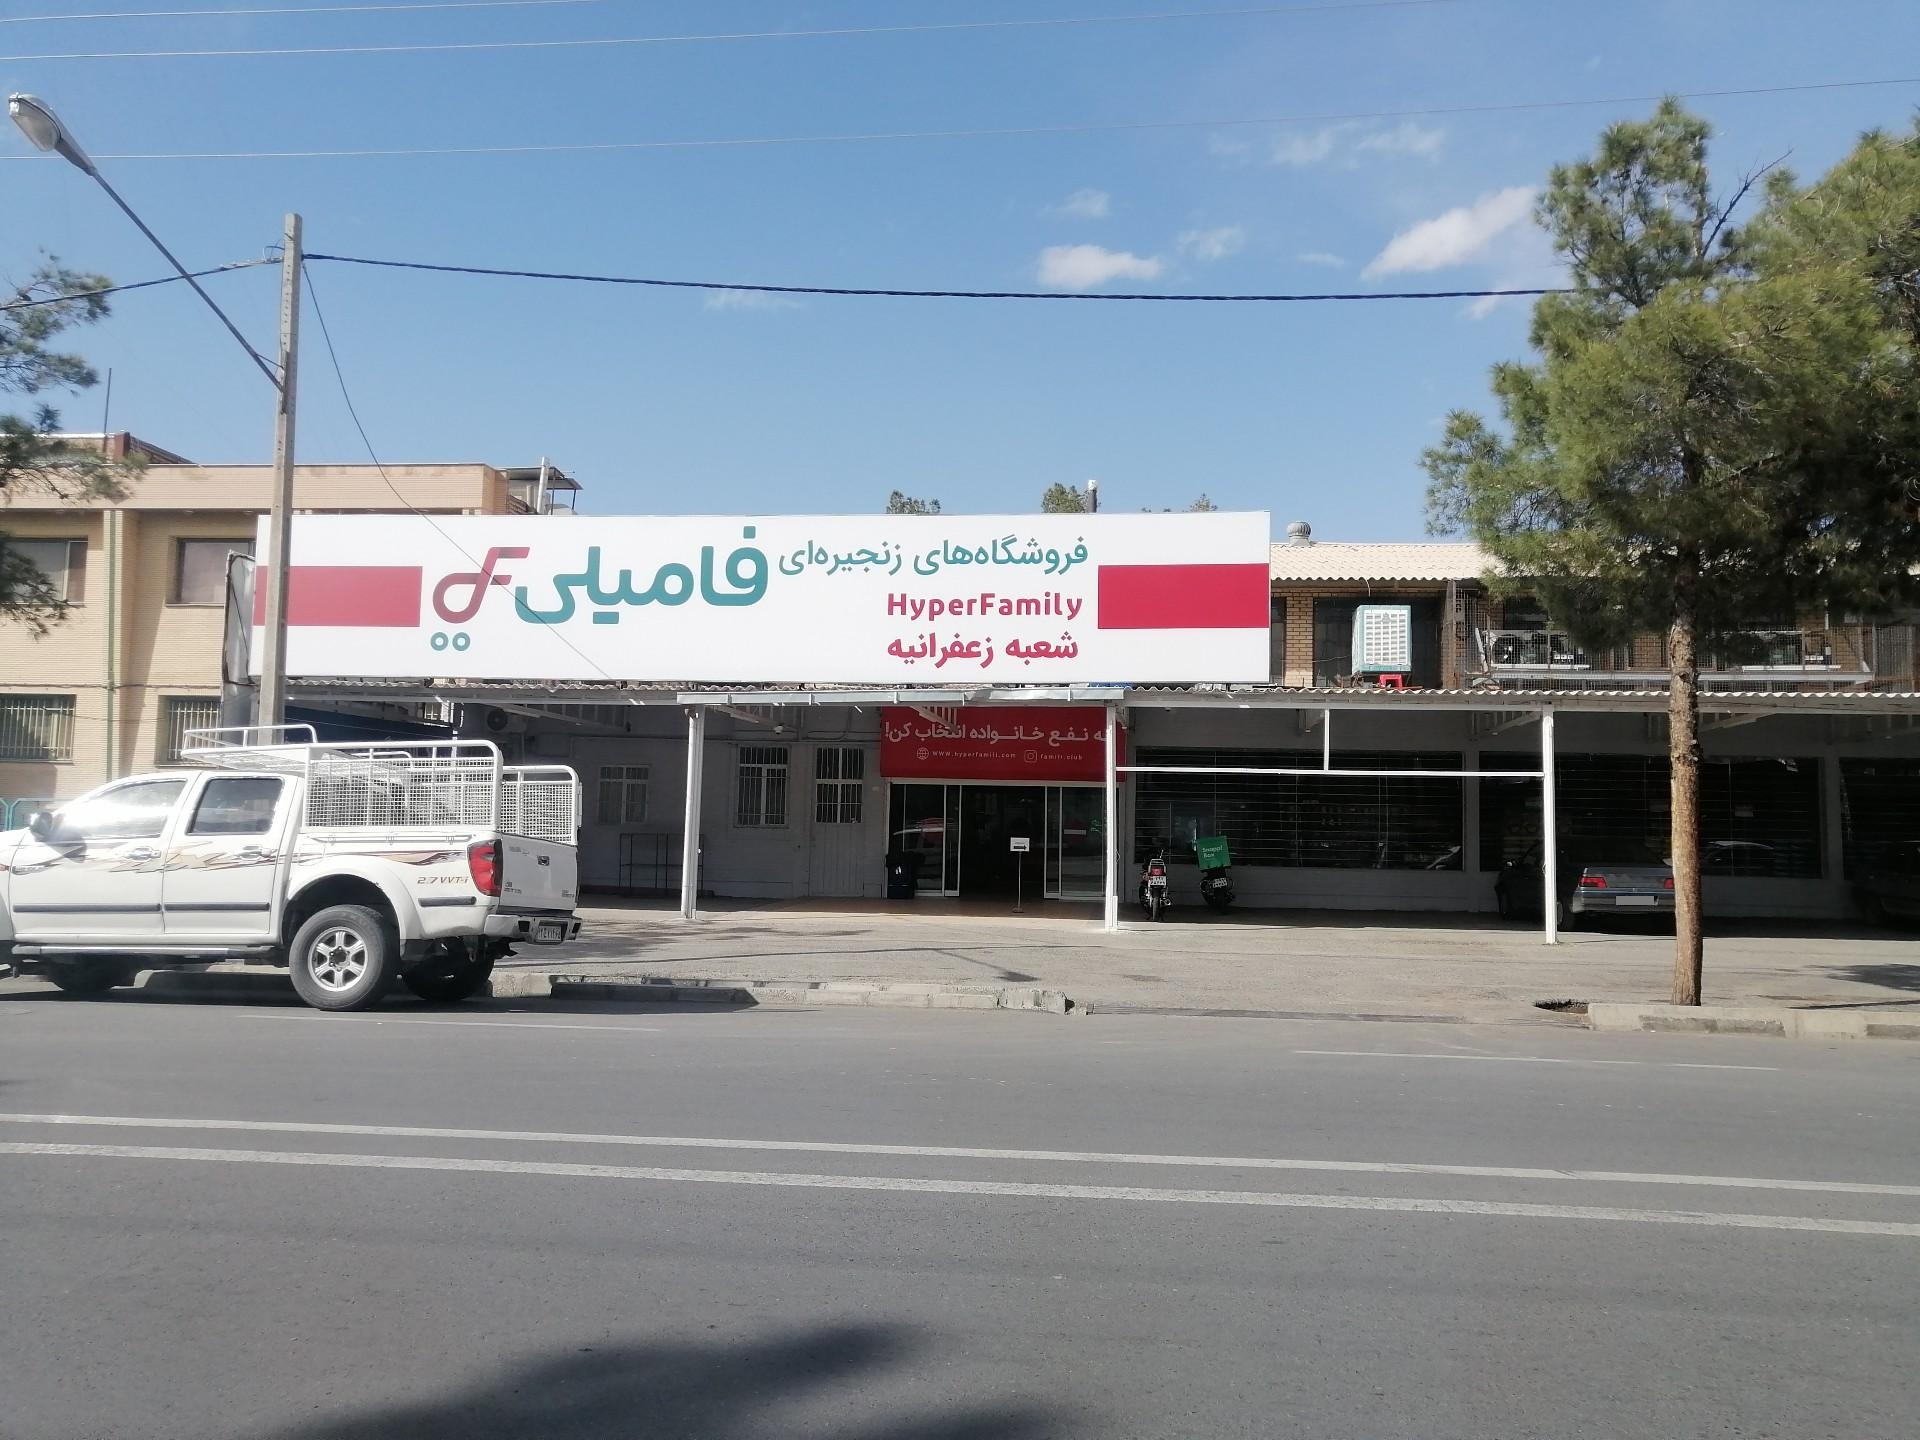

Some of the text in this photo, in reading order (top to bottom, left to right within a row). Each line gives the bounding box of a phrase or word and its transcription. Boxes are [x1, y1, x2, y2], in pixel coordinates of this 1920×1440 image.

[514, 526, 769, 625] فامیلی
[887, 592, 1083, 621] HyperFamily
[887, 631, 1079, 669] شعبه زعفرانیه
